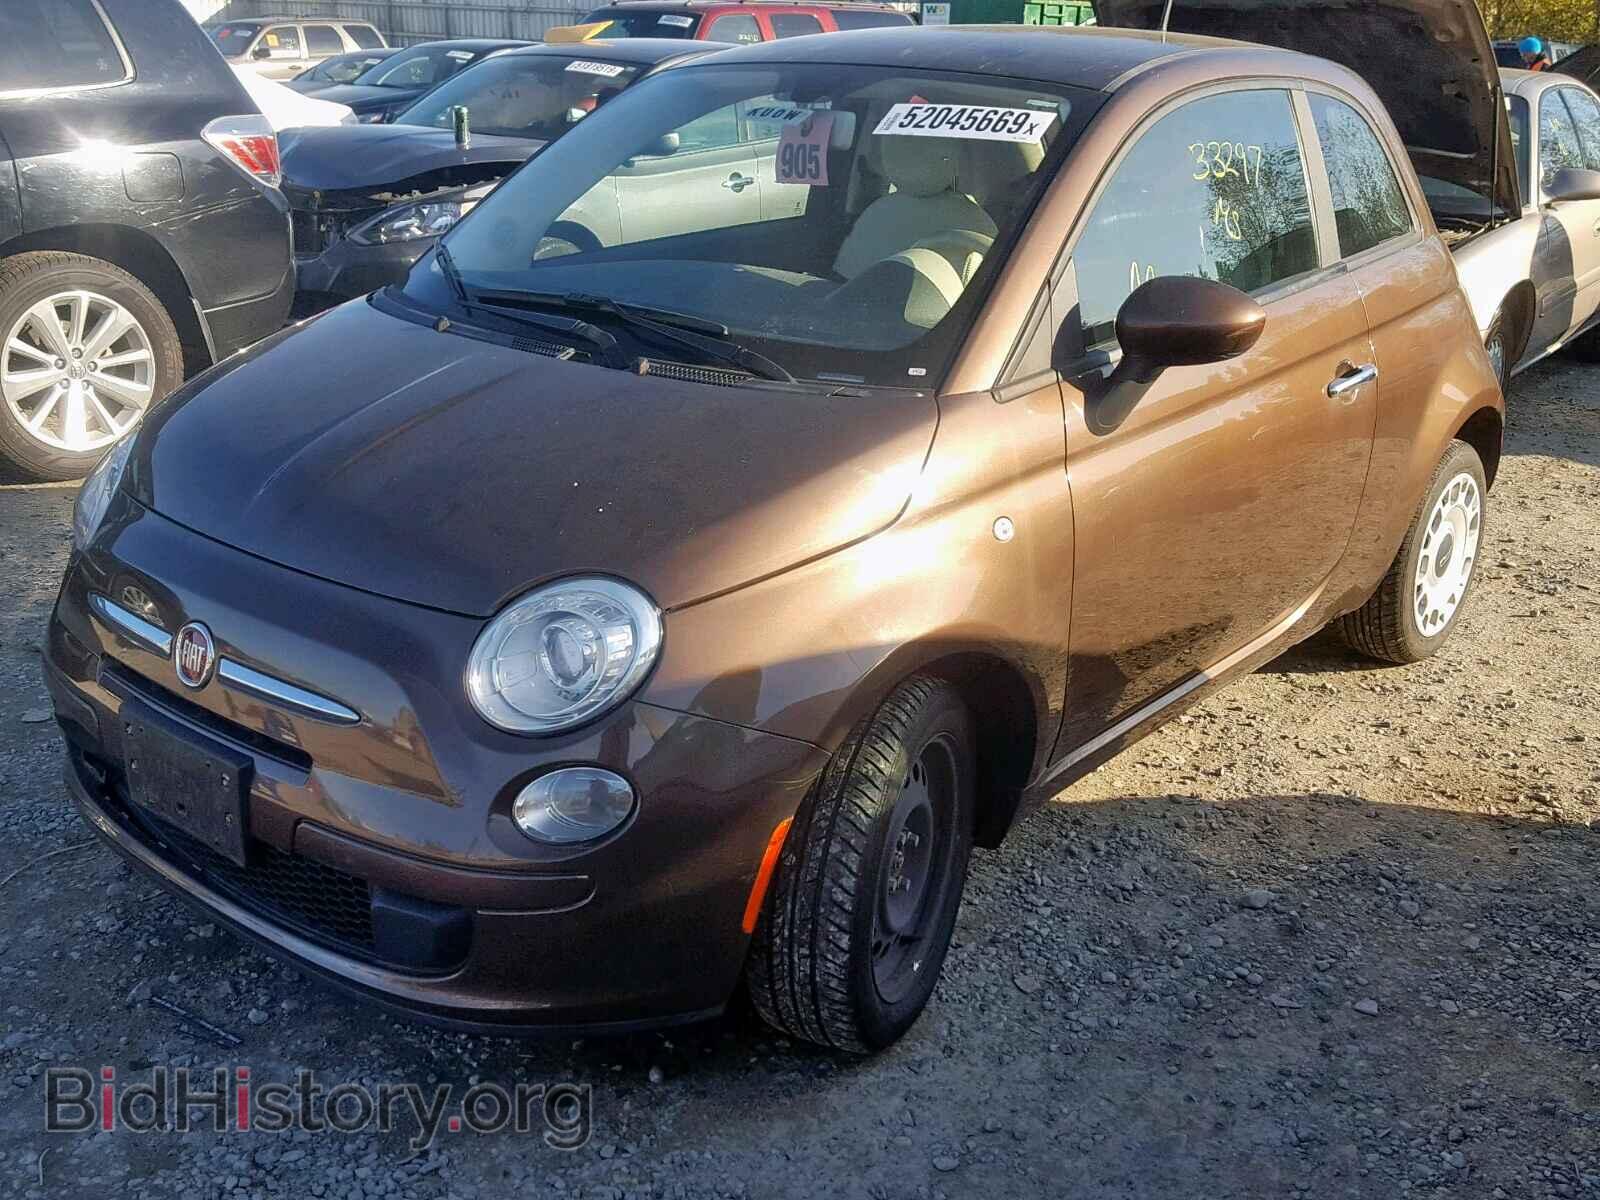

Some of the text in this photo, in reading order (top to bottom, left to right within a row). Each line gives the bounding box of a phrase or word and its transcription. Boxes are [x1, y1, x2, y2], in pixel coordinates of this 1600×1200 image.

[899, 106, 1031, 134] 52045669
[781, 142, 821, 180] 905
[1188, 141, 1261, 188] 33297
[181, 639, 206, 673] FIAT
